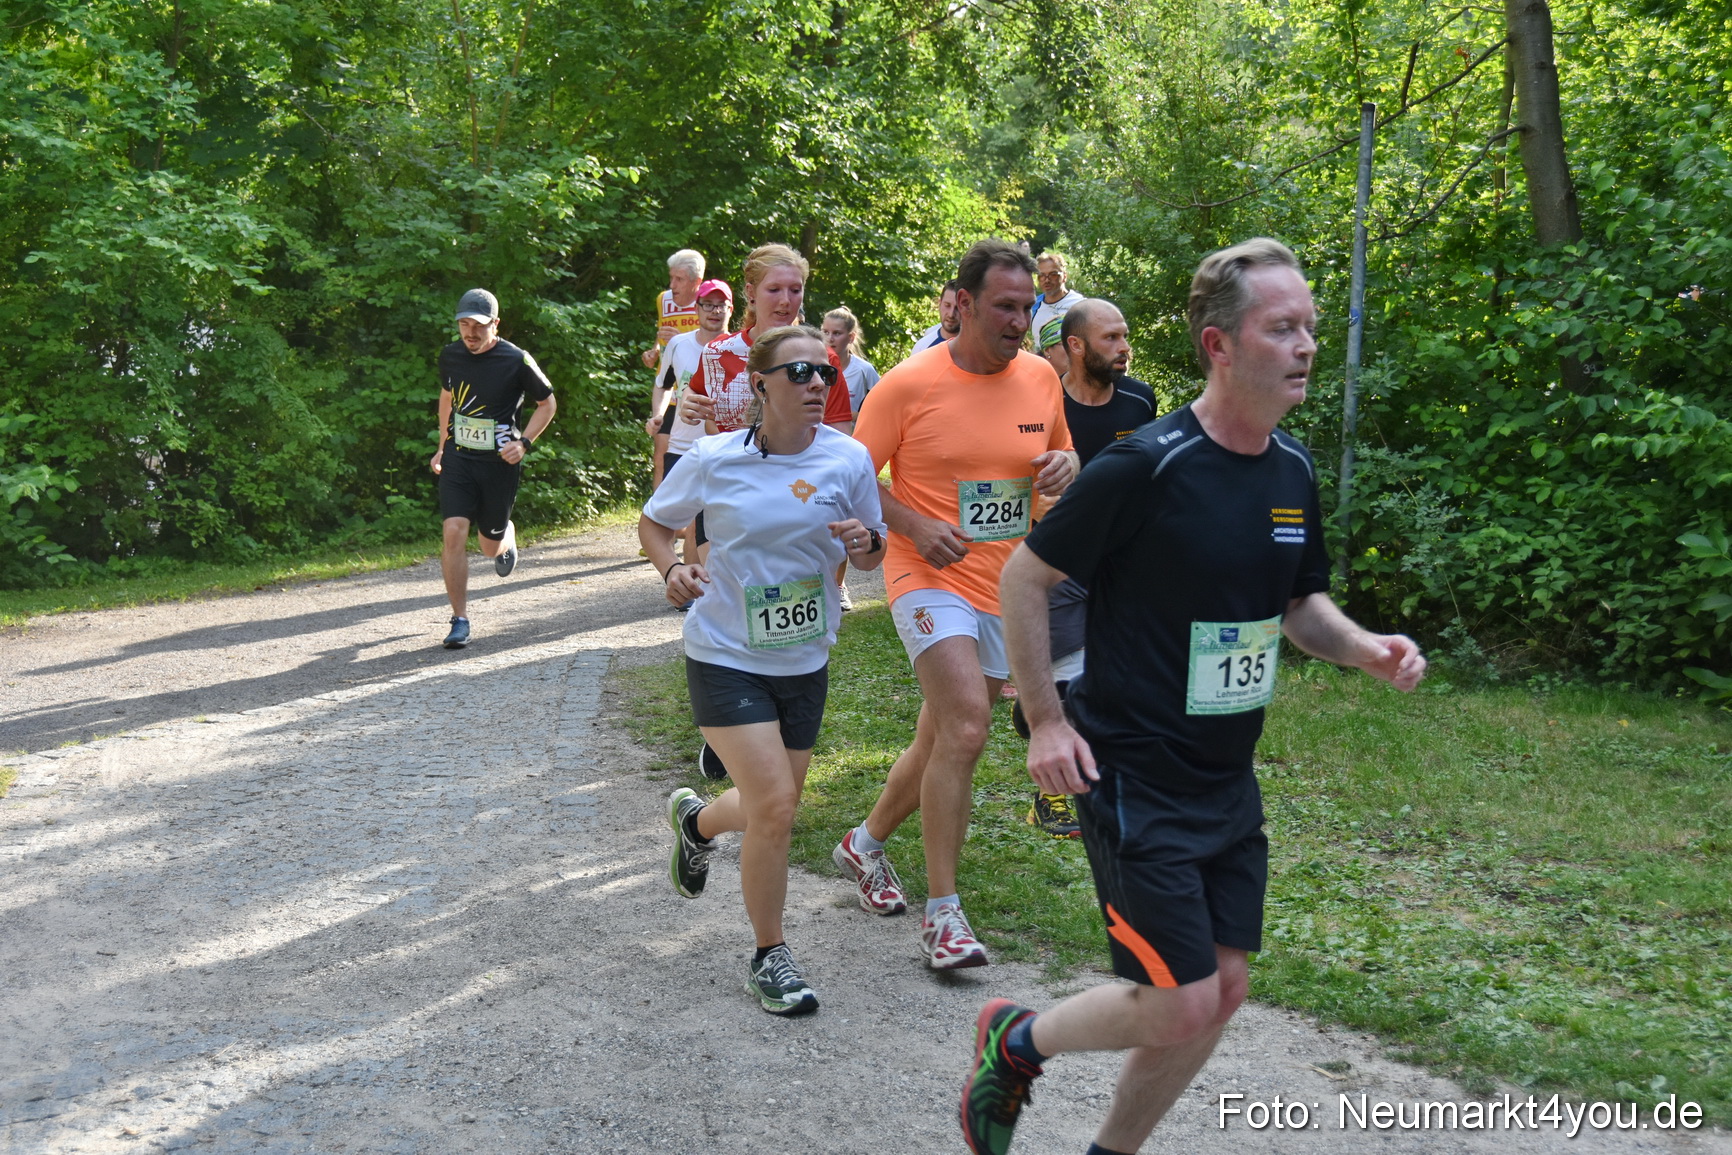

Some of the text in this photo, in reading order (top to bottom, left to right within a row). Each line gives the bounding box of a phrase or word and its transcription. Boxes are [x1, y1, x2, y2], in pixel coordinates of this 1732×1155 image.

[459, 426, 487, 441] 1741
[1018, 423, 1044, 433] THULE
[969, 499, 1024, 525] 2284
[978, 524, 995, 532] Blank
[759, 599, 818, 631] 1366
[765, 624, 816, 638] Tittmann Jasmin
[1218, 652, 1266, 688] 135
[1215, 689, 1250, 699] Lehmeier
